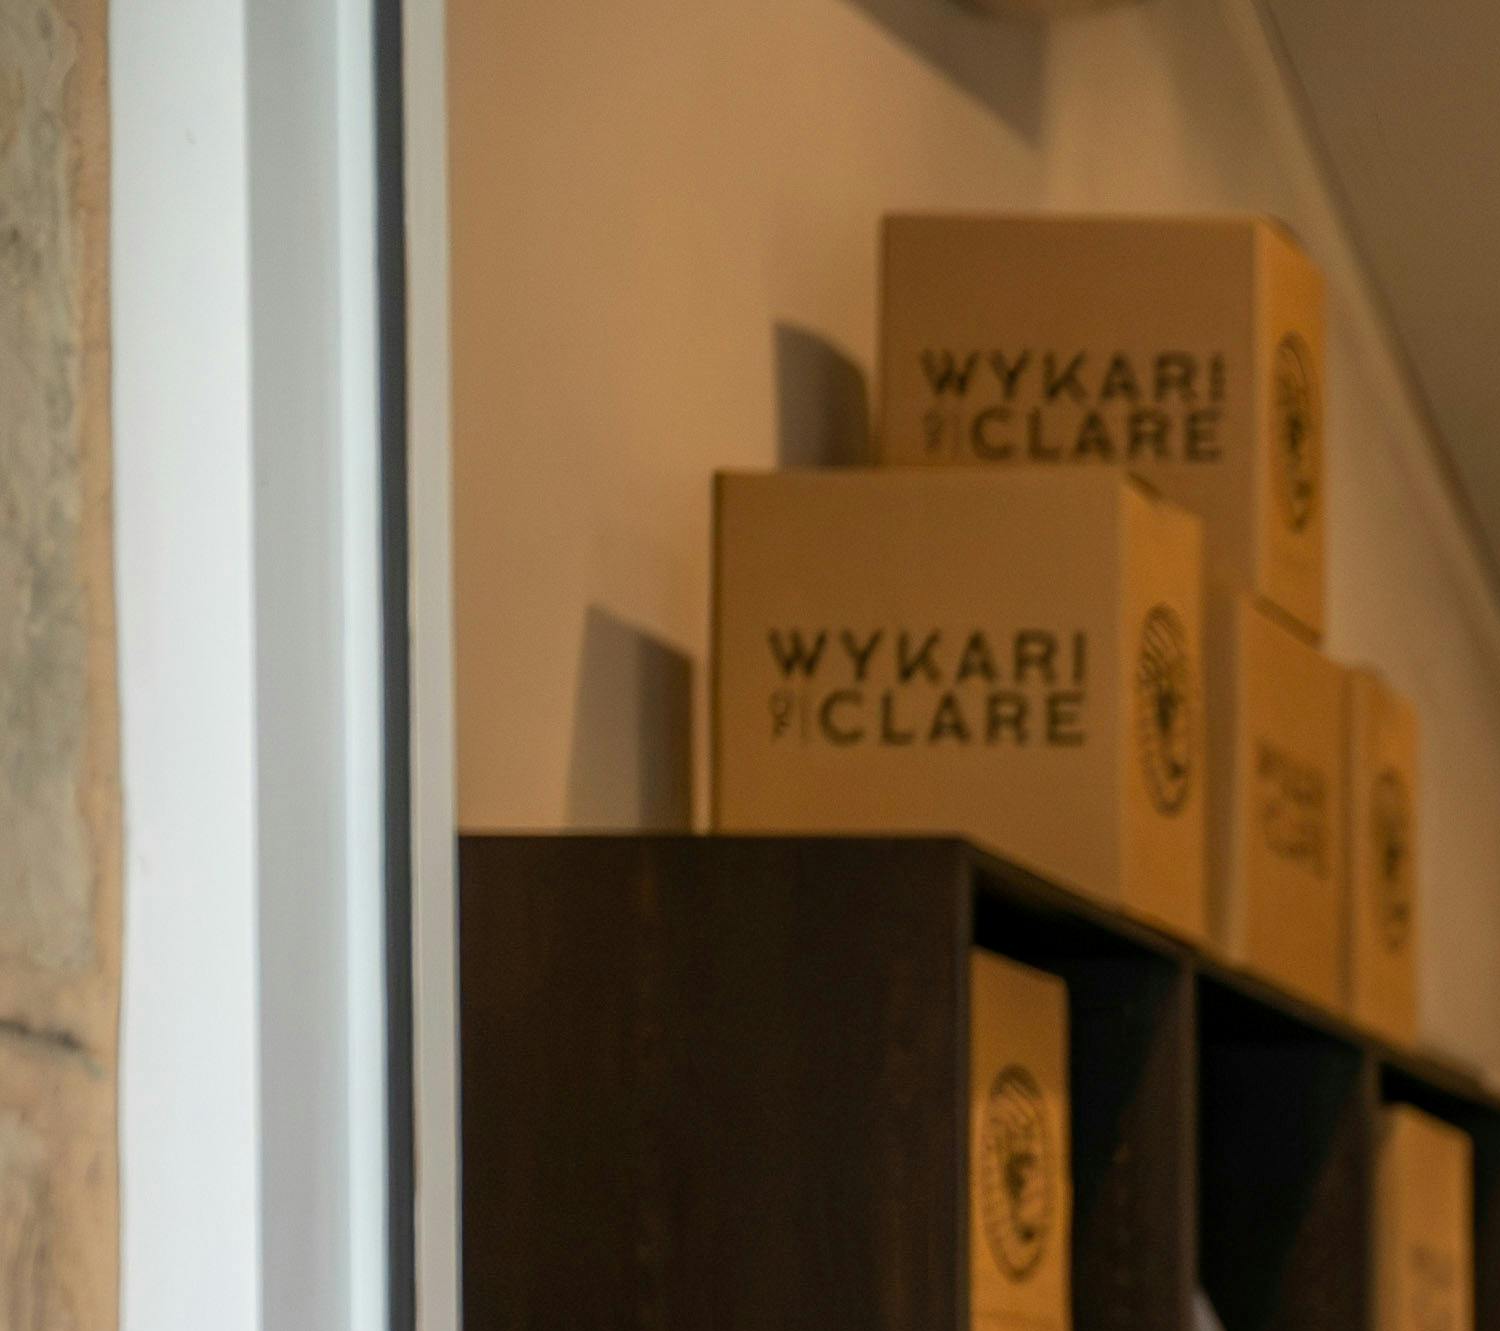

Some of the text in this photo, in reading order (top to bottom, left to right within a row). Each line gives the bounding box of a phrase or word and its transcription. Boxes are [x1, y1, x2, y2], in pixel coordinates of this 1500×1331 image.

[920, 349, 1226, 401] WYKARI
[969, 407, 1224, 463] CLARE
[768, 628, 1087, 684] WYKARI
[819, 690, 1087, 748] CLARE
